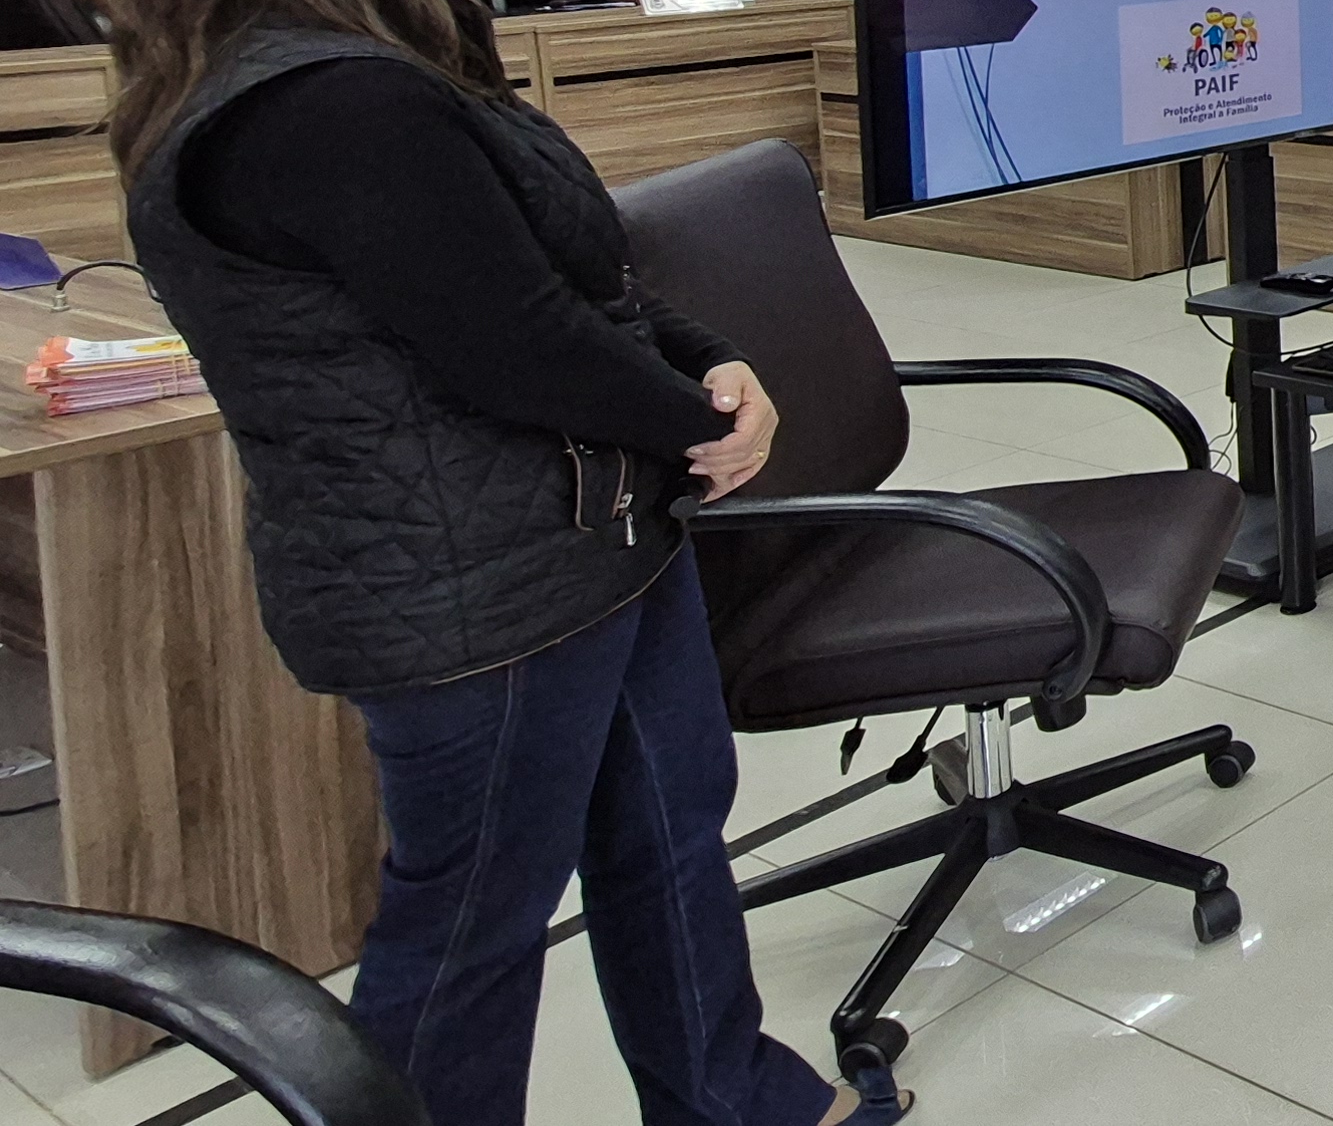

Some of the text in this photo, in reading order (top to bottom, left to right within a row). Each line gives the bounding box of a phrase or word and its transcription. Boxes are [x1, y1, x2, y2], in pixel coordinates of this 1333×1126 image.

[1194, 73, 1240, 96] PAIF
[1163, 103, 1206, 117] Proteção
[1216, 92, 1272, 109] Atendimento
[1179, 110, 1216, 124] Integral
[1226, 104, 1259, 116] Família
